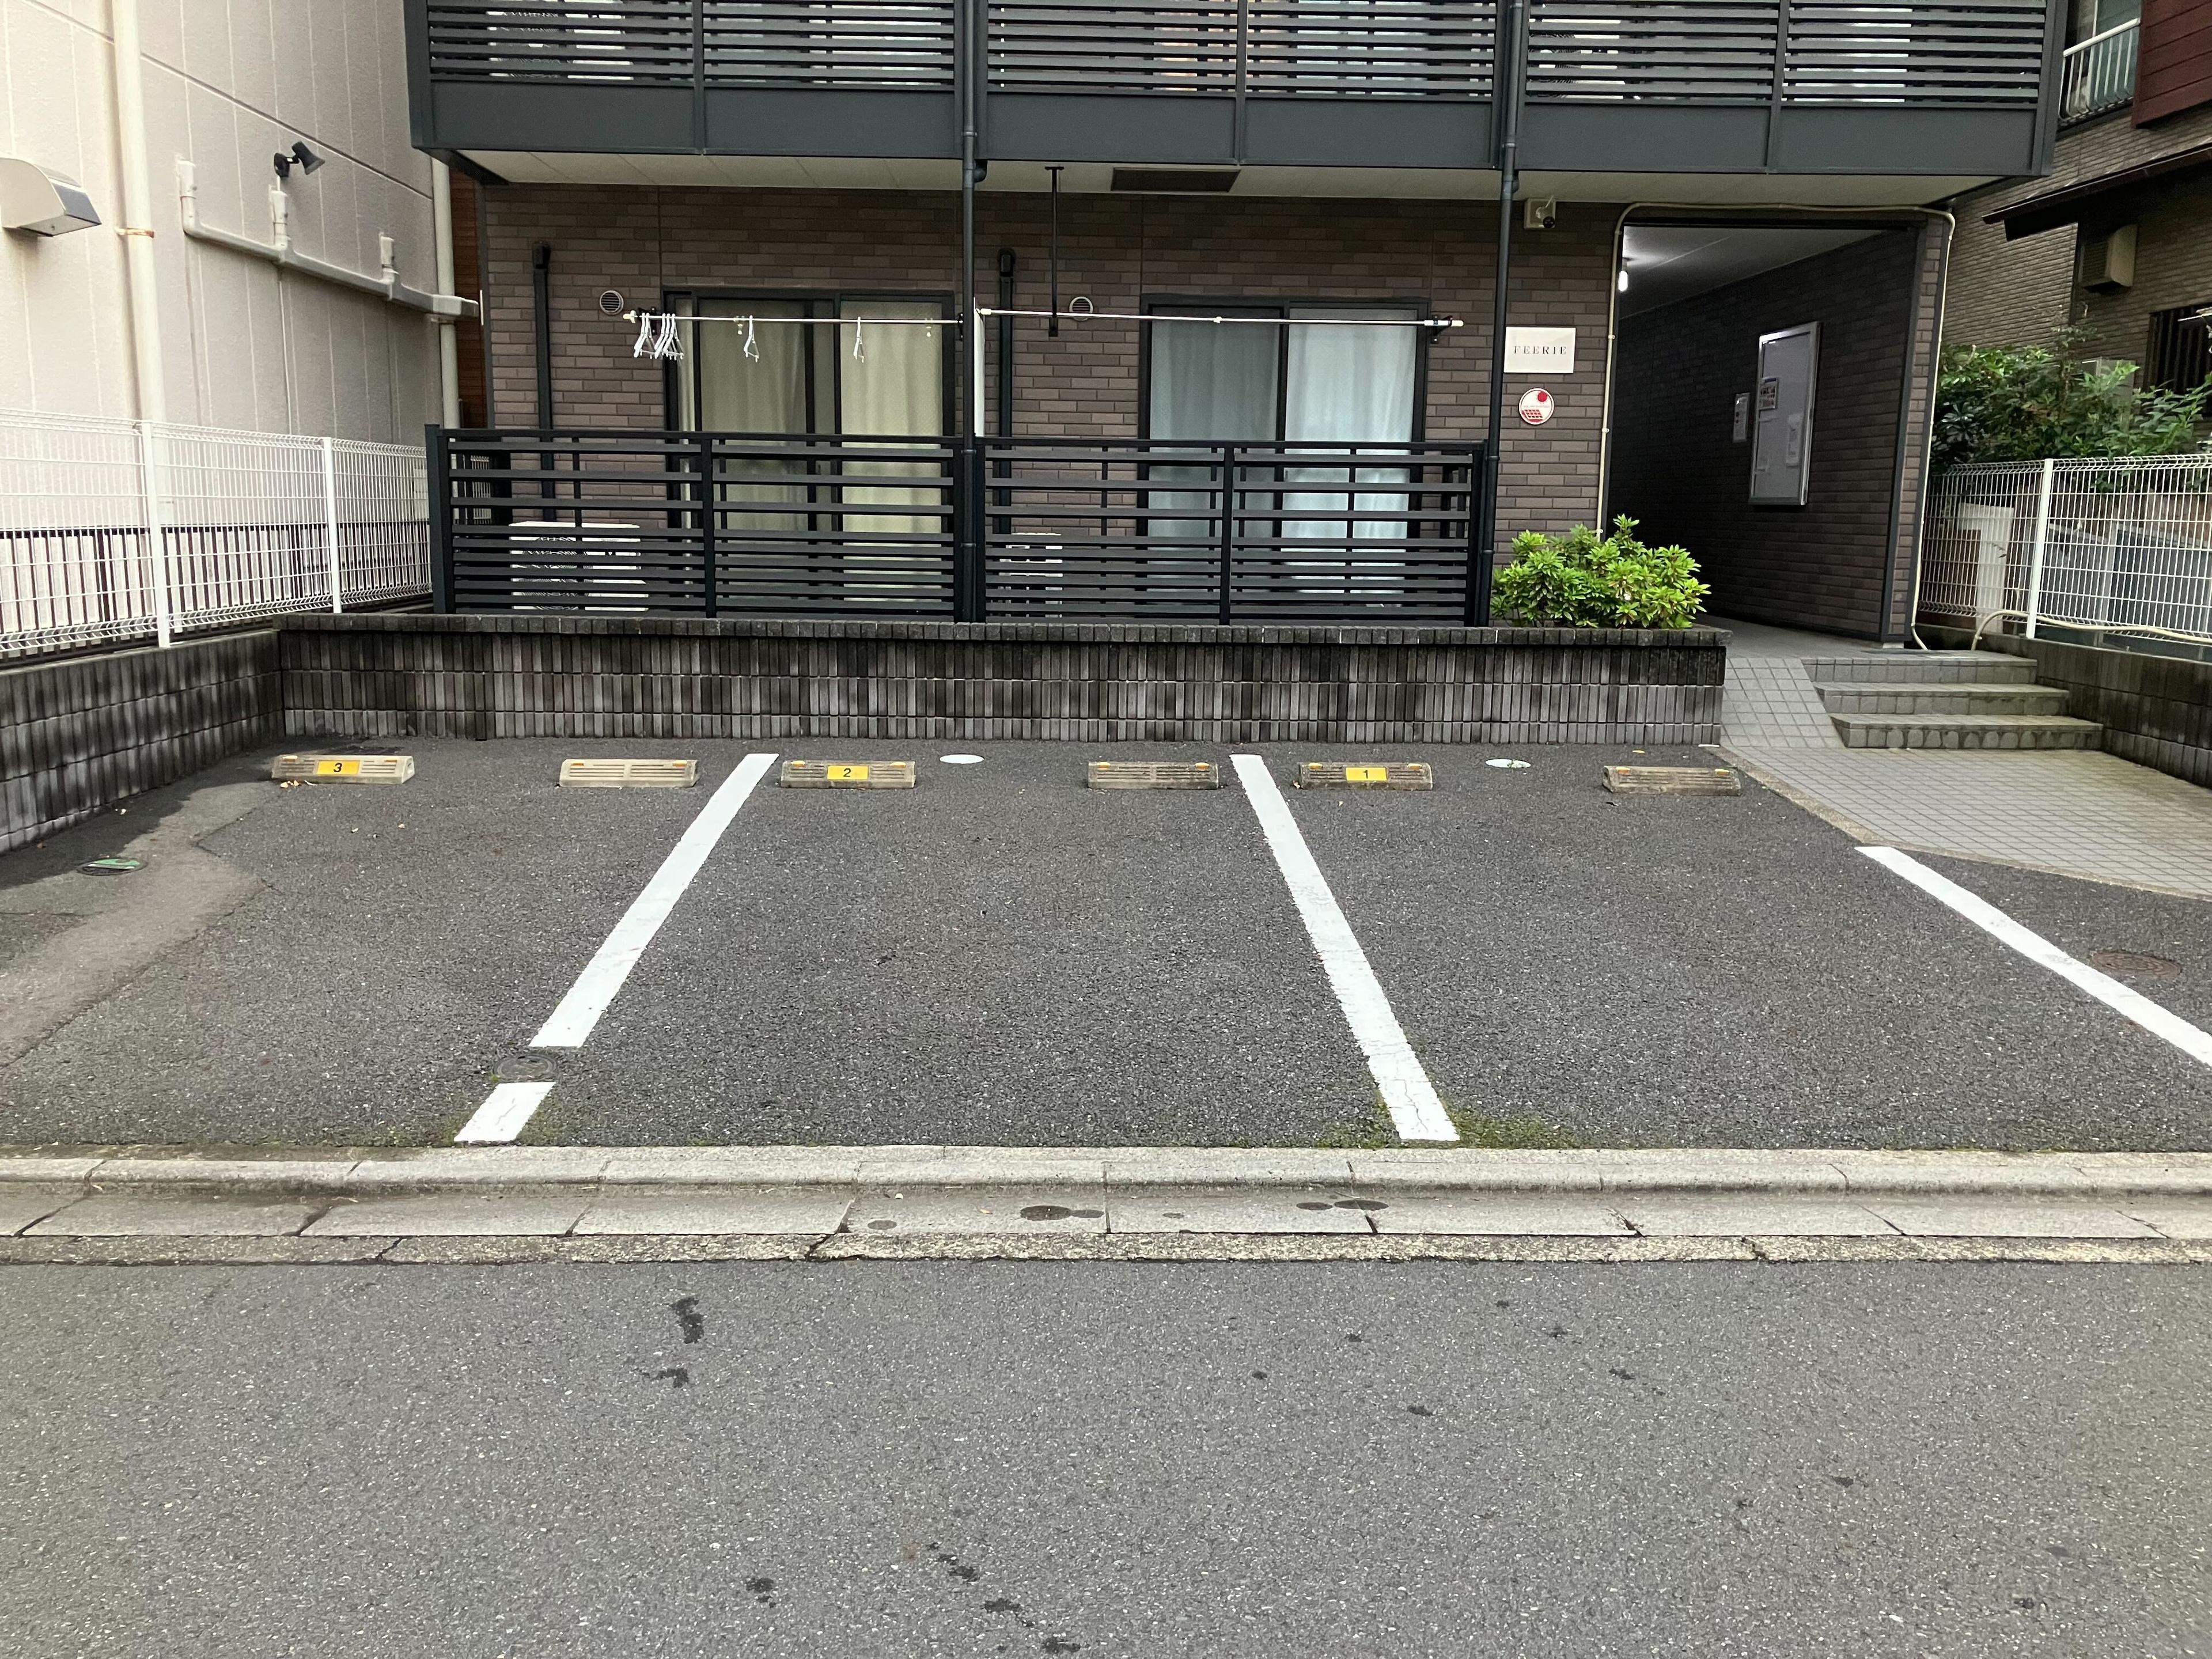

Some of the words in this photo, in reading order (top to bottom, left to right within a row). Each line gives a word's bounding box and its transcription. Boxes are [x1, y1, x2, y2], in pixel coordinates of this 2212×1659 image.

[1513, 346, 1567, 355] FEERIE
[333, 762, 343, 772] 3
[843, 767, 851, 778] 2
[1362, 770, 1369, 779] 1
